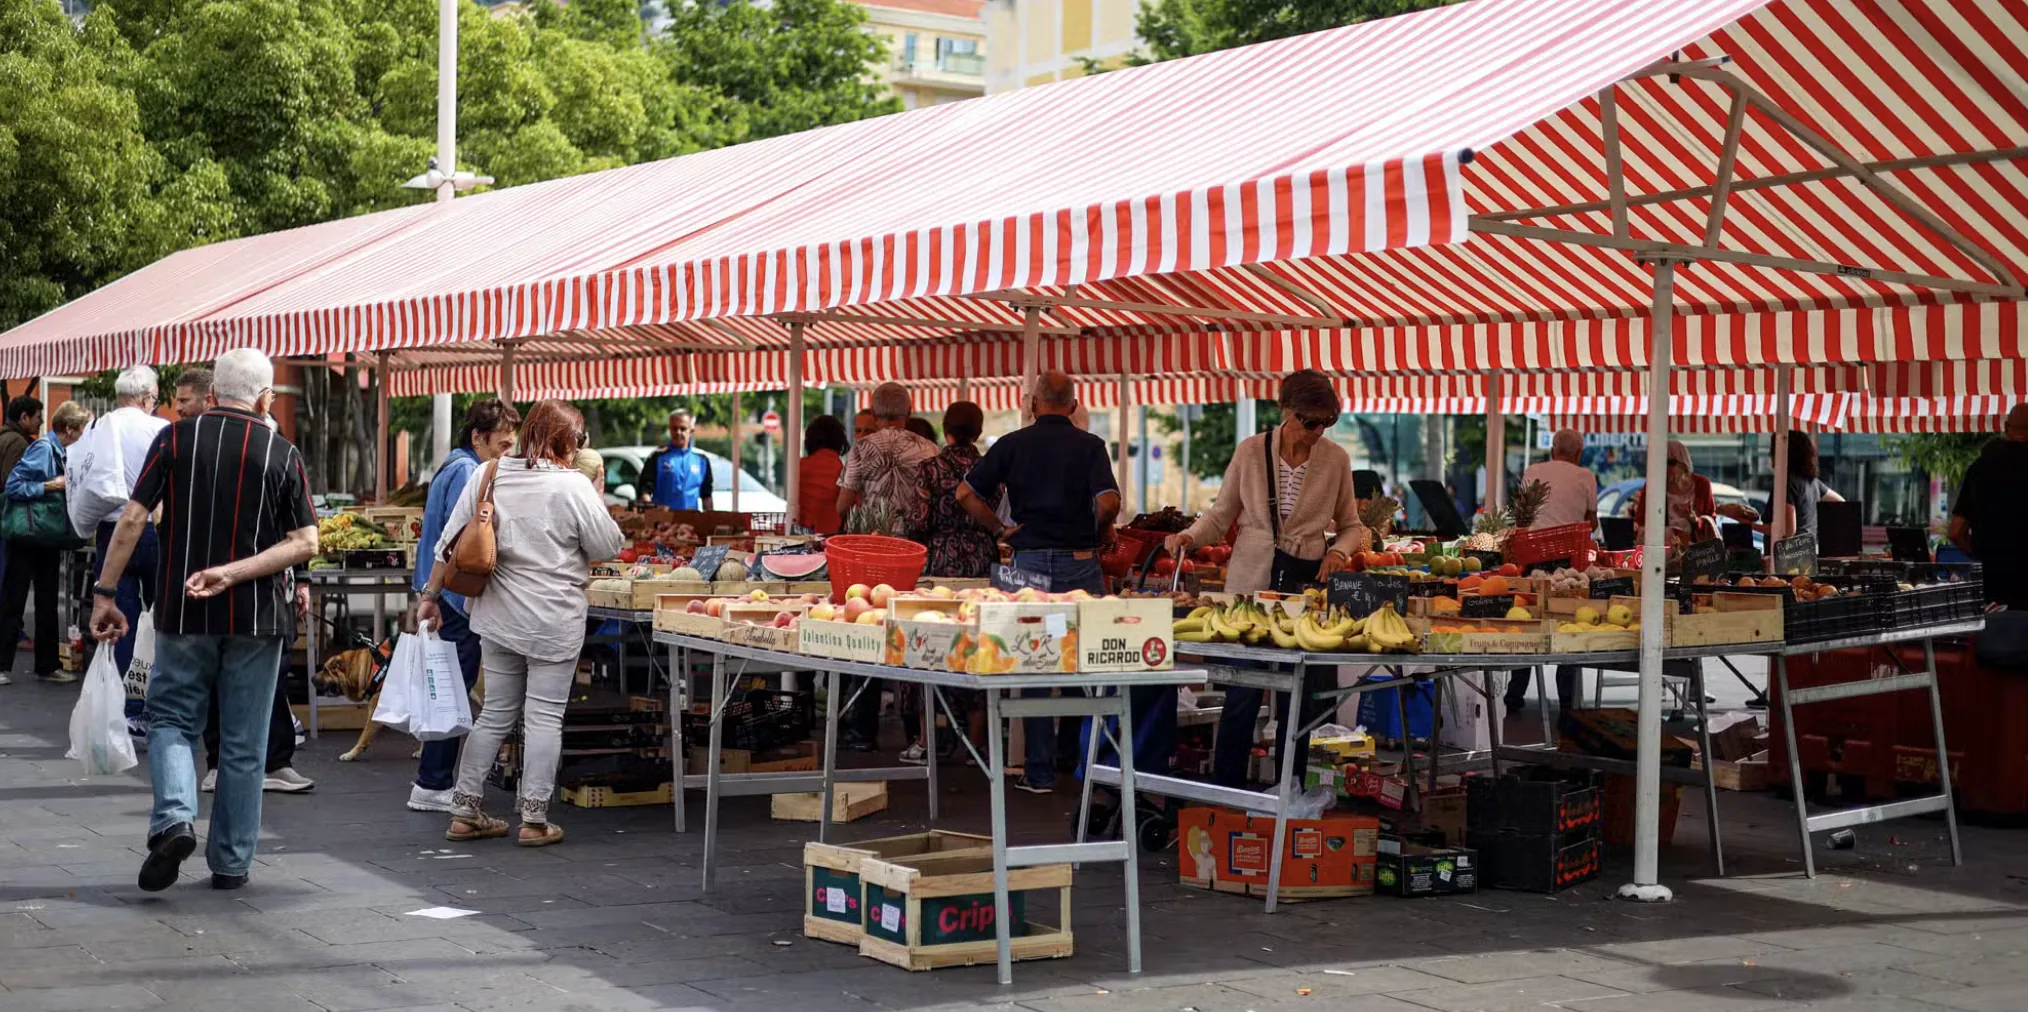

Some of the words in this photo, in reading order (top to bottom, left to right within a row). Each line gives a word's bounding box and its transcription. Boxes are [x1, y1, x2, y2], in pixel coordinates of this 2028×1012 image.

[803, 629, 842, 647] Valentina
[846, 634, 881, 653] Quality
[1102, 638, 1126, 651] DON
[1470, 638, 1490, 648] Fruits
[1087, 651, 1140, 665] RICARDO
[128, 670, 147, 685] est
